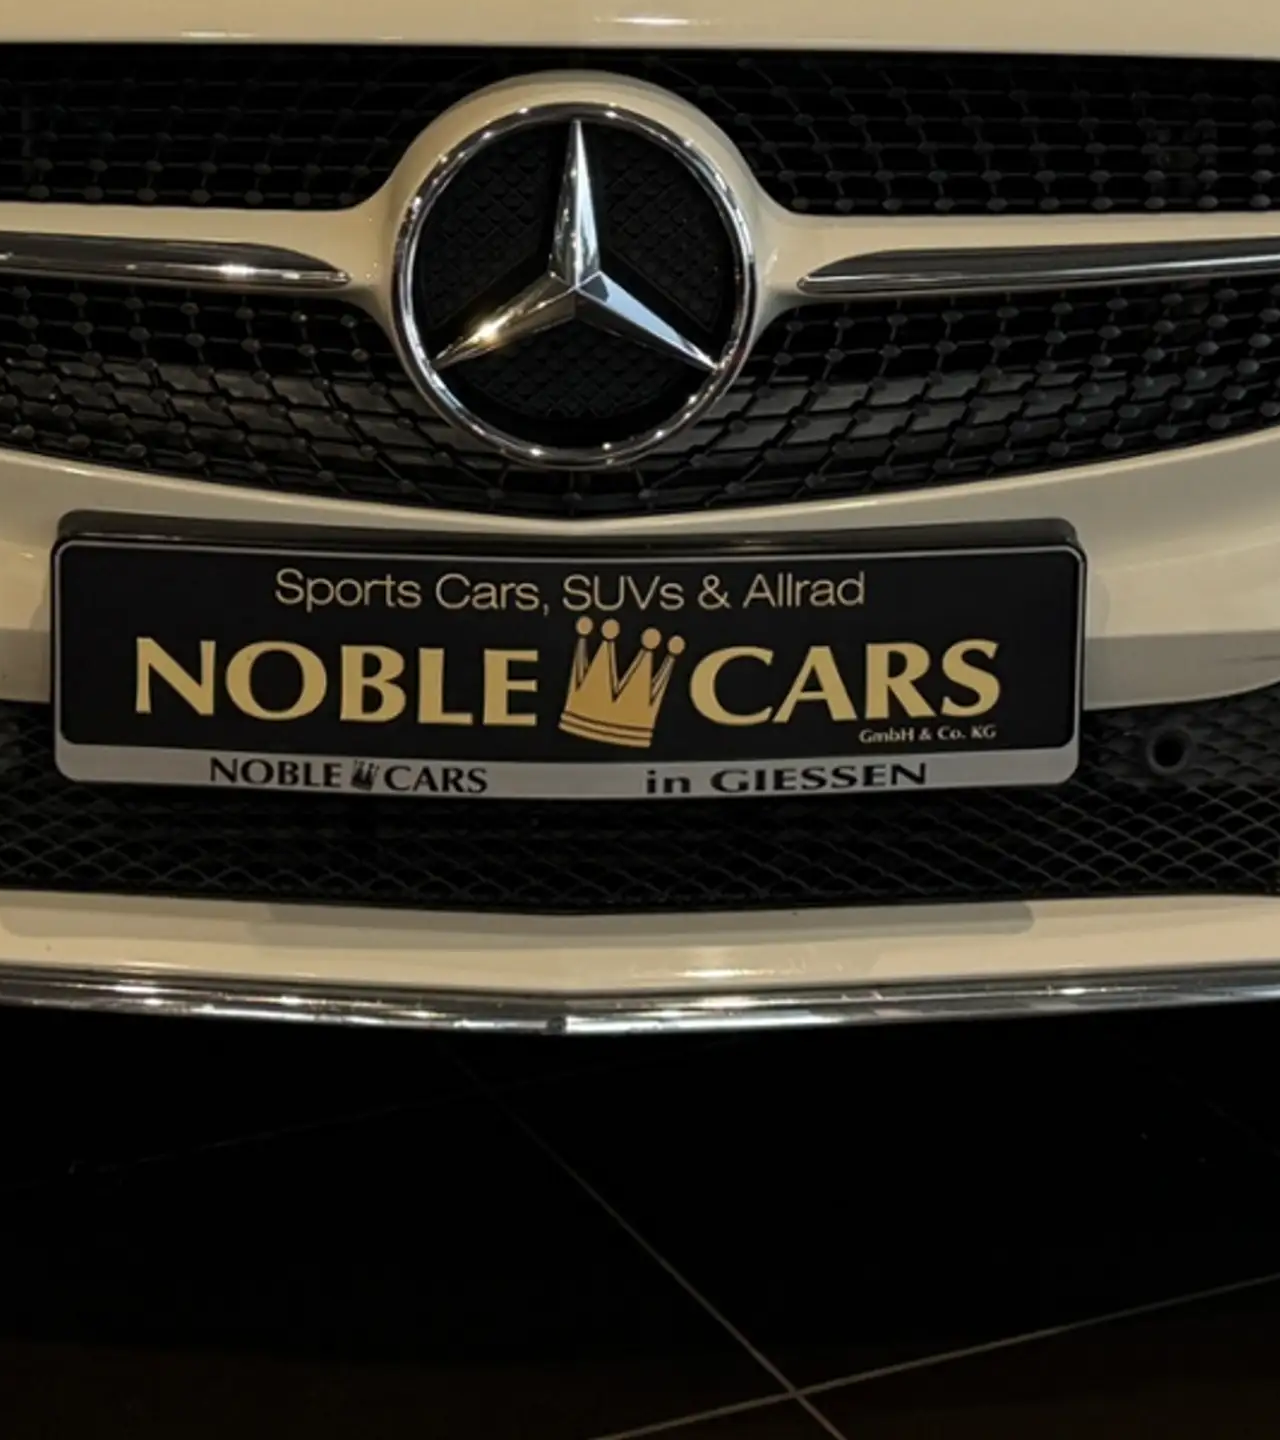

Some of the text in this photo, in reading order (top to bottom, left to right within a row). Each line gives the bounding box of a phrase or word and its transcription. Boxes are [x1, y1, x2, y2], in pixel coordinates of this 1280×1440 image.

[275, 568, 866, 616] Sports Cars, SUVs & Allrad
[134, 637, 1002, 727] NOBLE CARS
[858, 724, 997, 744] GmbH & Co. KG
[209, 756, 927, 795] NOBLE CARS in GIESSEN
